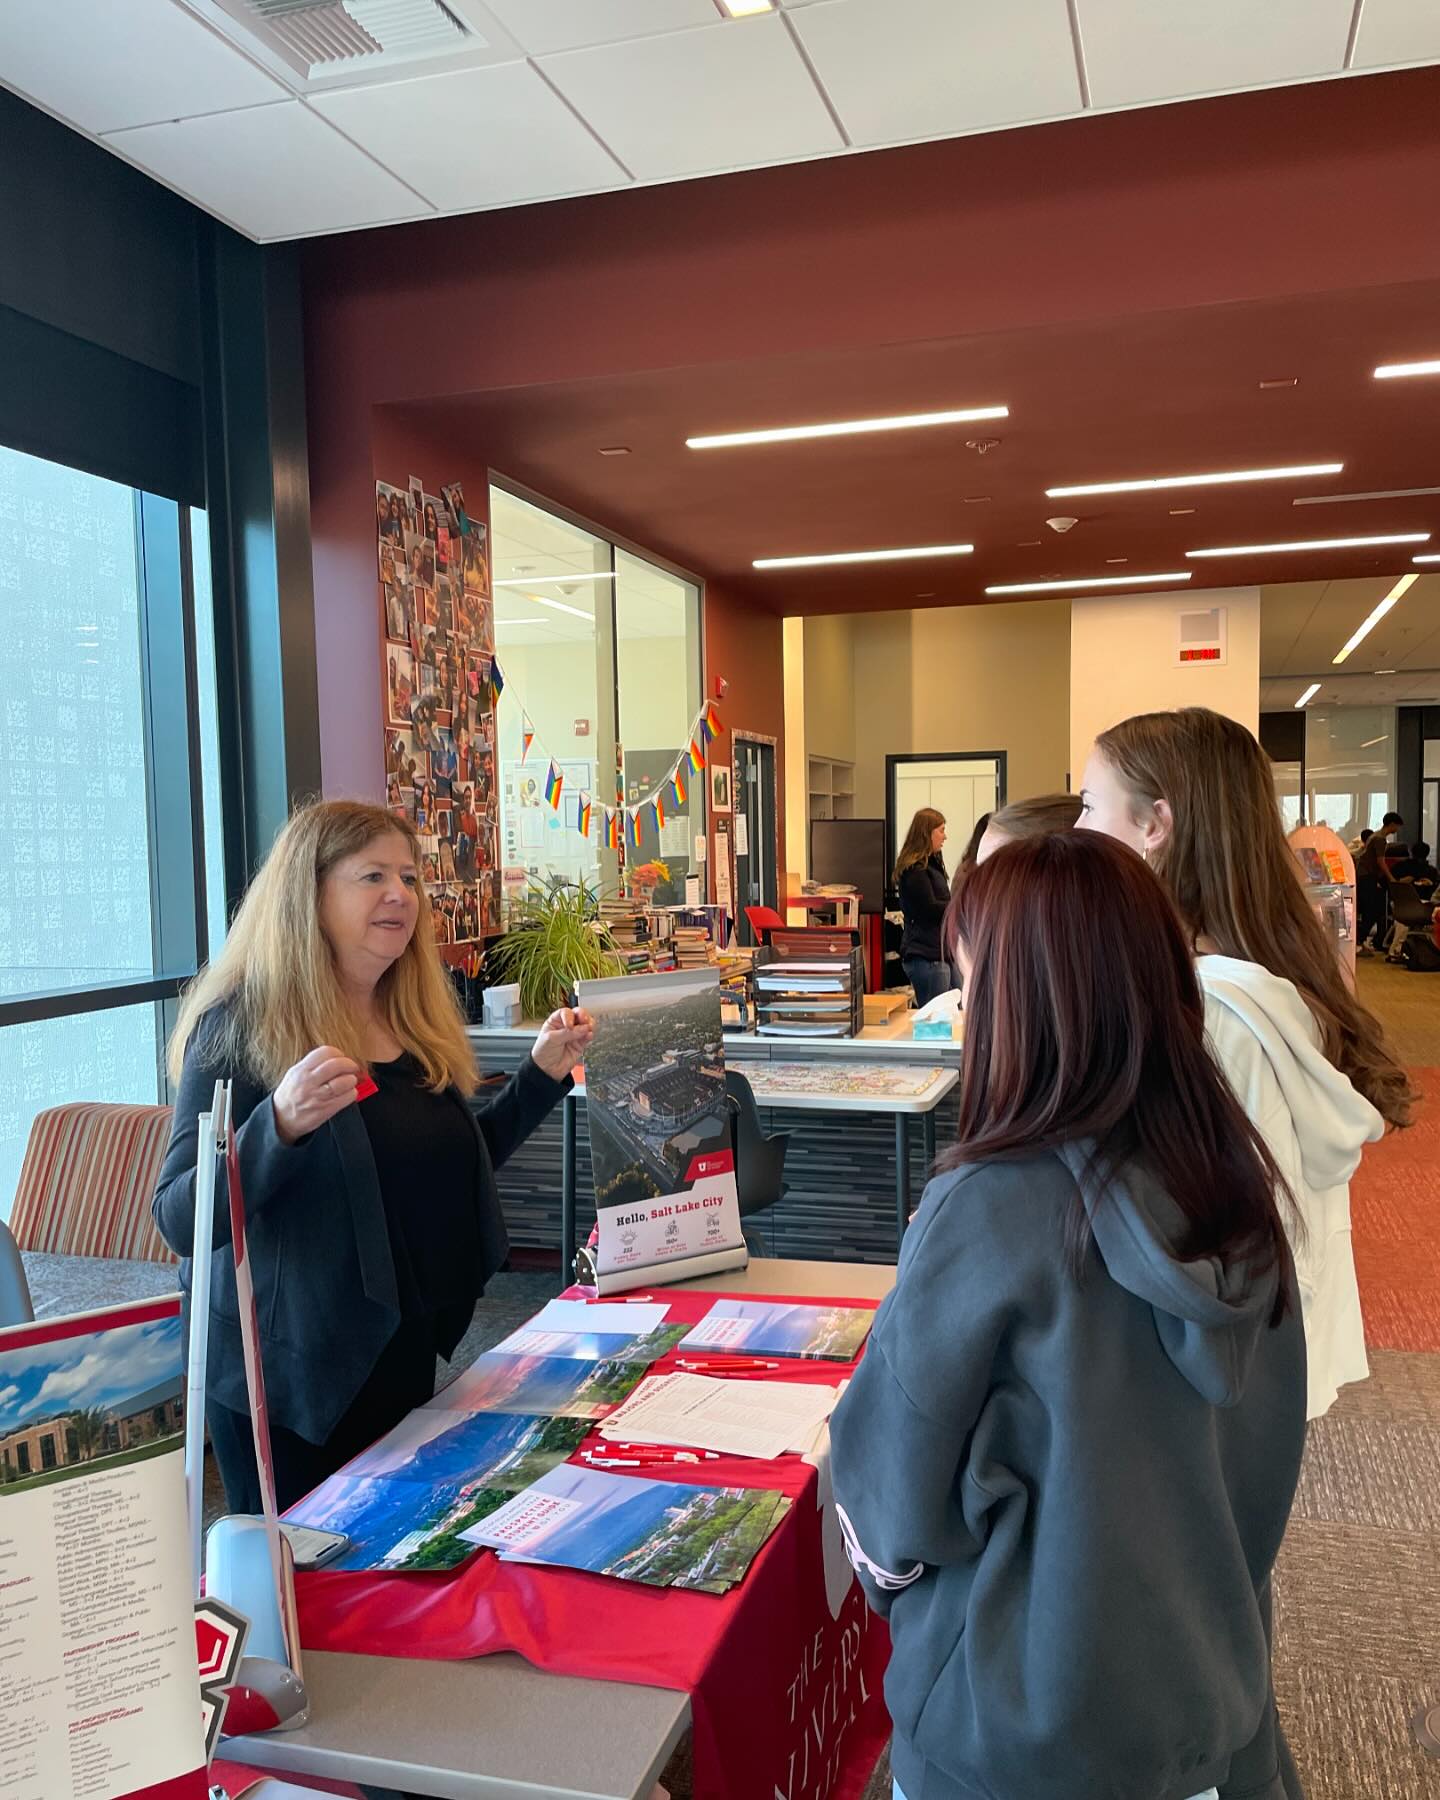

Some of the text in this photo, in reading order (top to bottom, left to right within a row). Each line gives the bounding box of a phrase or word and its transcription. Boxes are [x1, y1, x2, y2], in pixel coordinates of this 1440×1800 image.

[616, 1196, 723, 1226] Hello, Salt Lake City
[493, 1498, 550, 1537] PROSPECTIVE
[504, 1516, 539, 1540] STUDENT
[537, 1501, 561, 1518] GUIDE
[64, 1631, 139, 1657] PARTNERSHIP PROGRAMS
[787, 1626, 824, 1724] THE
[109, 1707, 143, 1720] PROGRAMS
